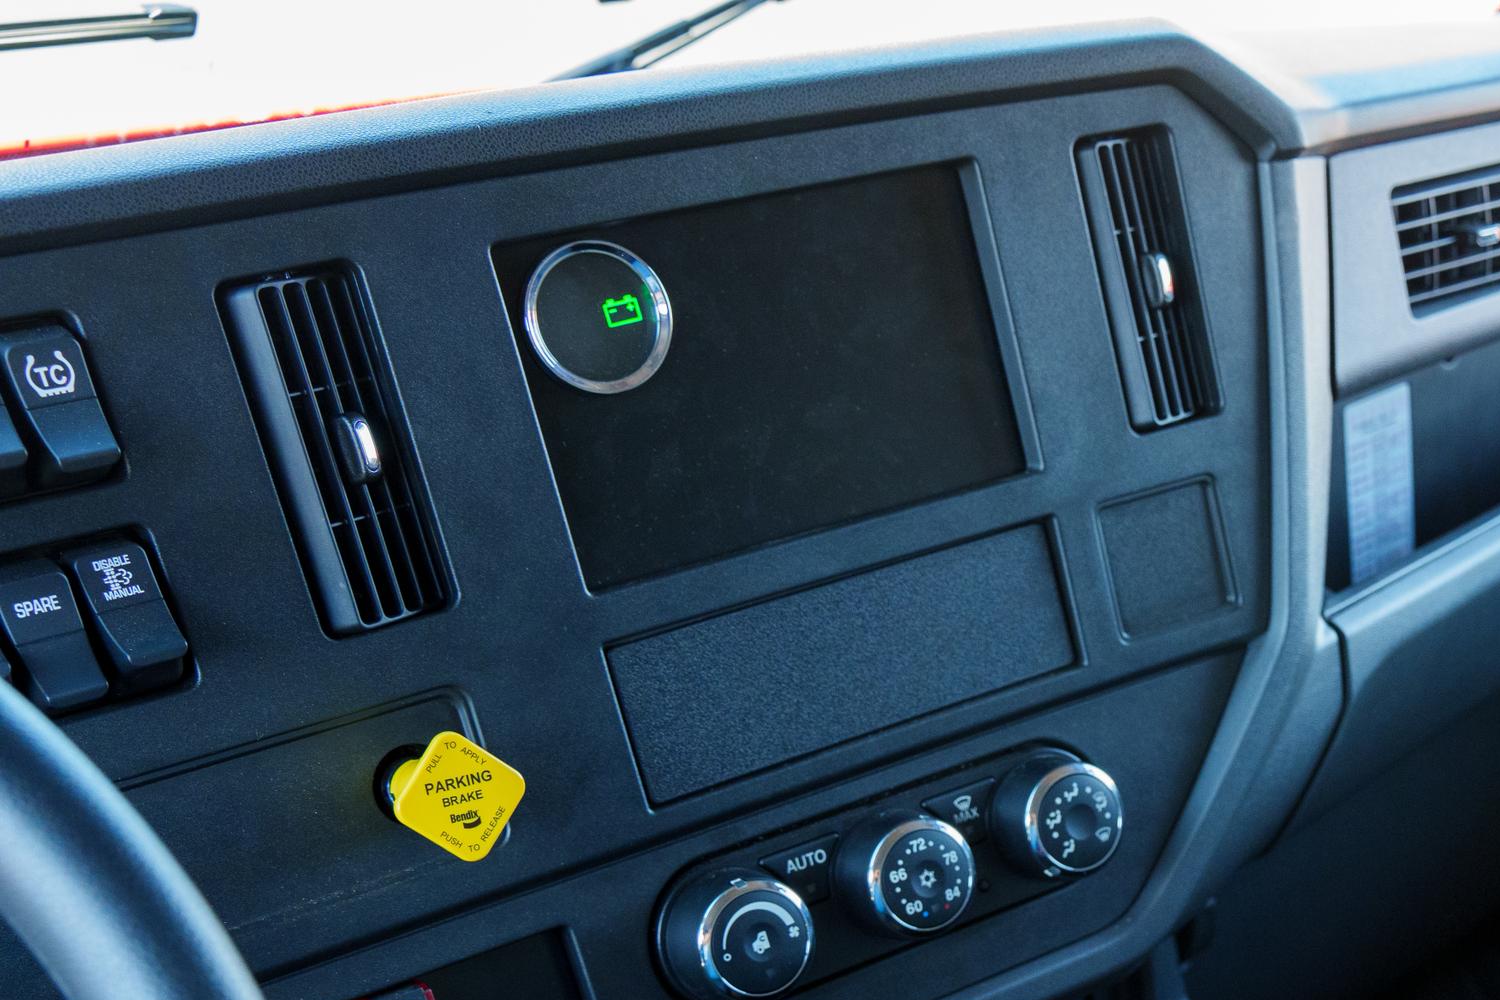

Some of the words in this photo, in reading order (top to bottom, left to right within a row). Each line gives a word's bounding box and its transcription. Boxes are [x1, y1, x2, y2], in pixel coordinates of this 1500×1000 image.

[34, 365, 67, 388] TC
[92, 554, 131, 572] DISABLE
[104, 585, 145, 602] MANUAL
[14, 594, 61, 620] SPARE
[426, 754, 442, 773] PULL
[444, 741, 457, 750] TO
[460, 747, 487, 766] APPLY
[425, 770, 492, 795] PARKING
[442, 789, 483, 807] BRAKE
[450, 809, 480, 823] Bendix
[954, 807, 980, 824] MAX
[440, 831, 463, 848] PUSH
[468, 843, 480, 852] TO
[481, 806, 506, 842] RELEASE
[909, 838, 927, 853] 72
[786, 849, 827, 874] AUTO
[943, 850, 958, 865] 78
[889, 868, 907, 883] 66
[945, 886, 961, 901] 84
[905, 900, 923, 915] 60
